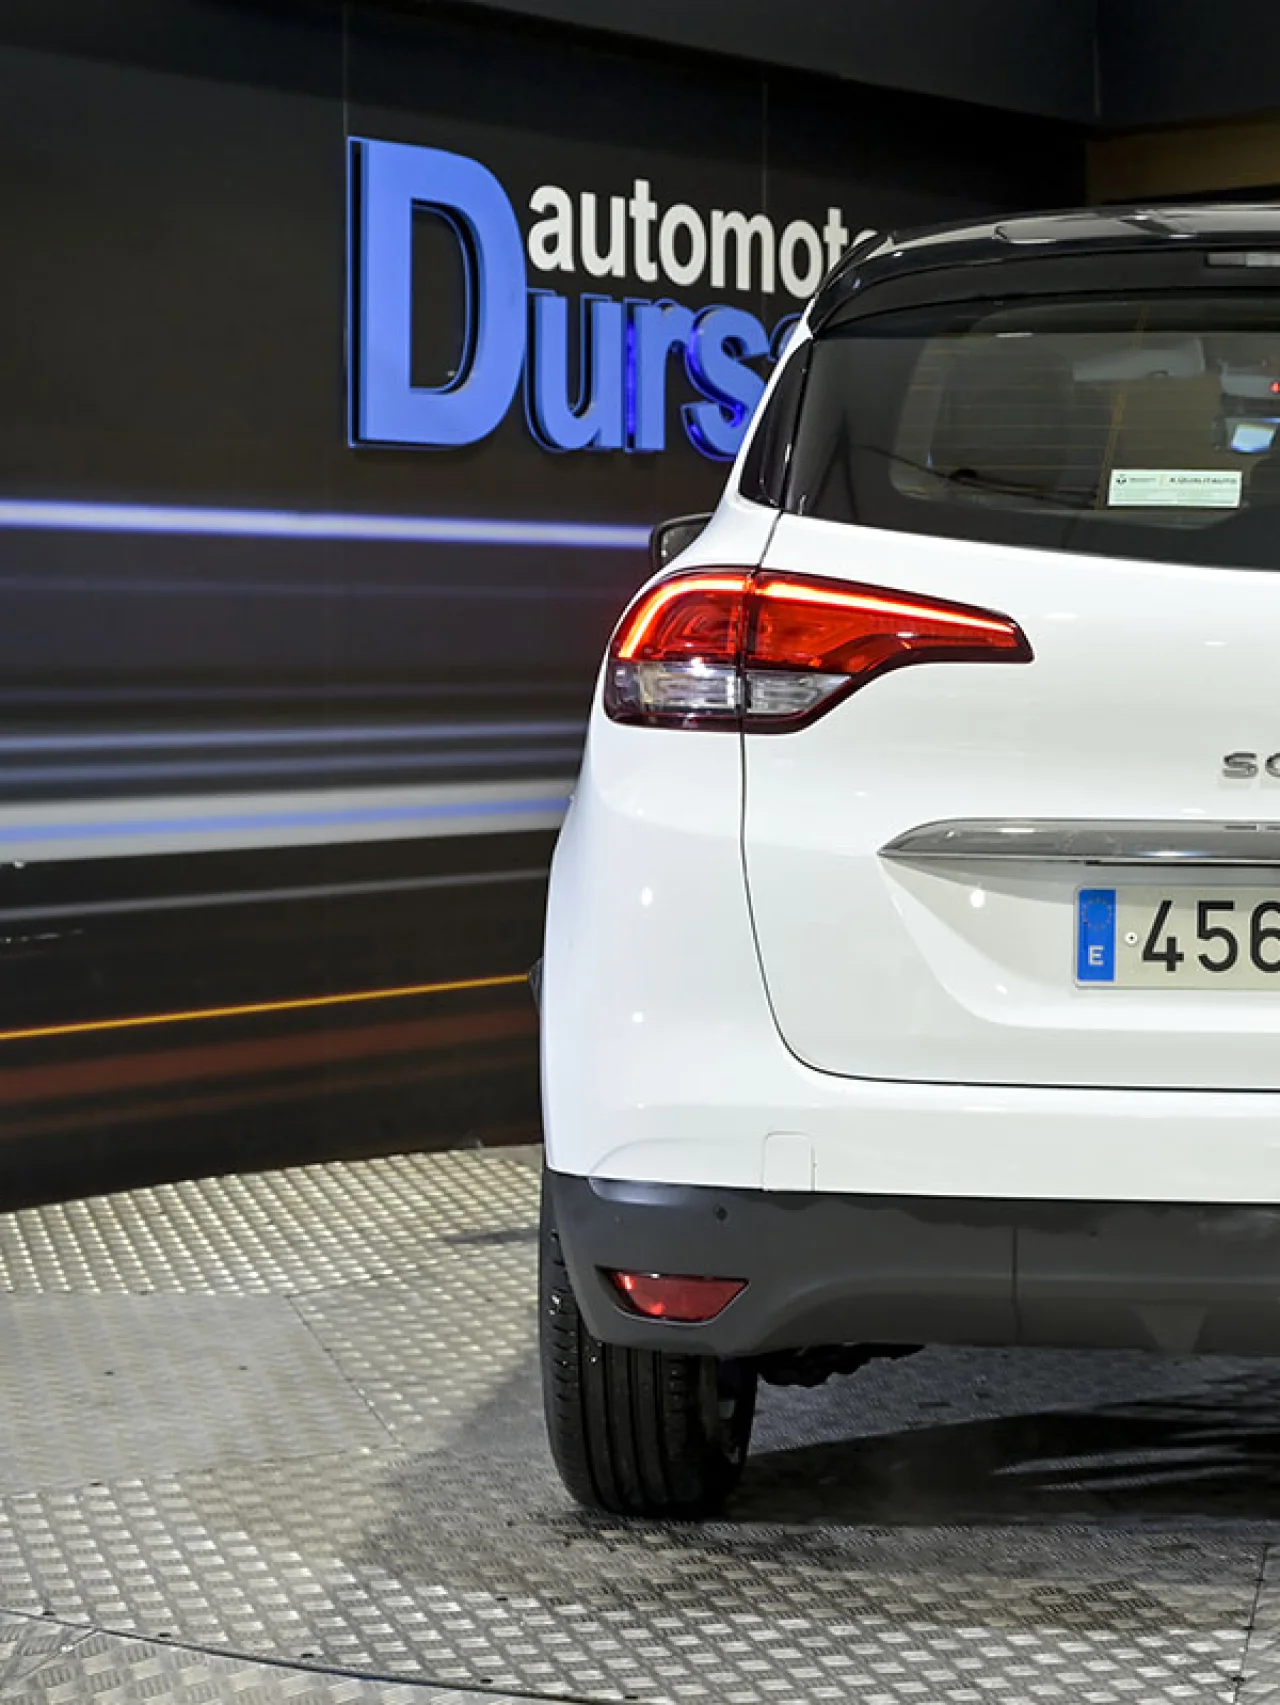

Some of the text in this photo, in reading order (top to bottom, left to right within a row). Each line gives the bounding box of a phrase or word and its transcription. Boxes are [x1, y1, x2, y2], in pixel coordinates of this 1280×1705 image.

[347, 136, 802, 462] Durs
[527, 179, 877, 299] automot
[1087, 946, 1105, 966] E
